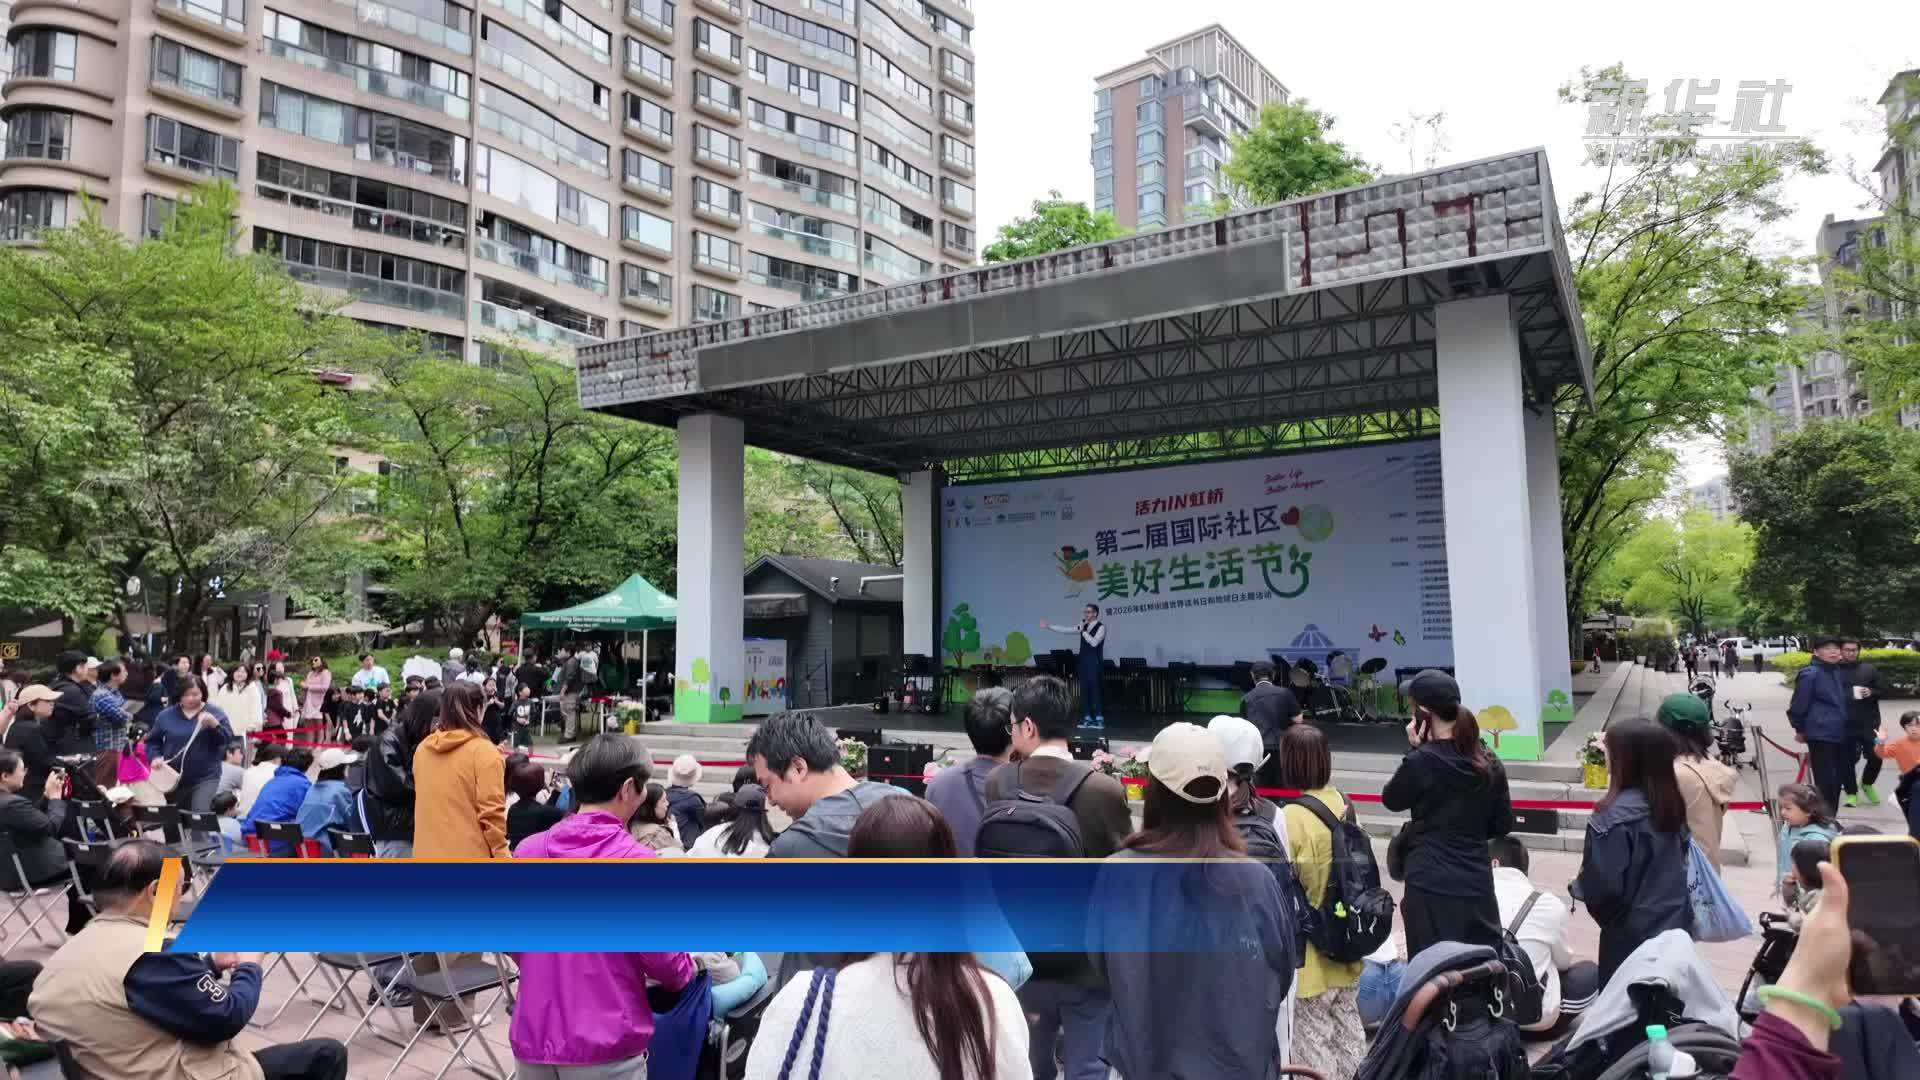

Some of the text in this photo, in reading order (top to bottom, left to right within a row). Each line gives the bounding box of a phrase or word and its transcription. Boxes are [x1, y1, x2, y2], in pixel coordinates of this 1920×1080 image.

[1135, 487, 1224, 516] 活力IN虹桥
[1095, 505, 1281, 555] 第二届国际社区
[1096, 541, 1312, 601] 美好生活节
